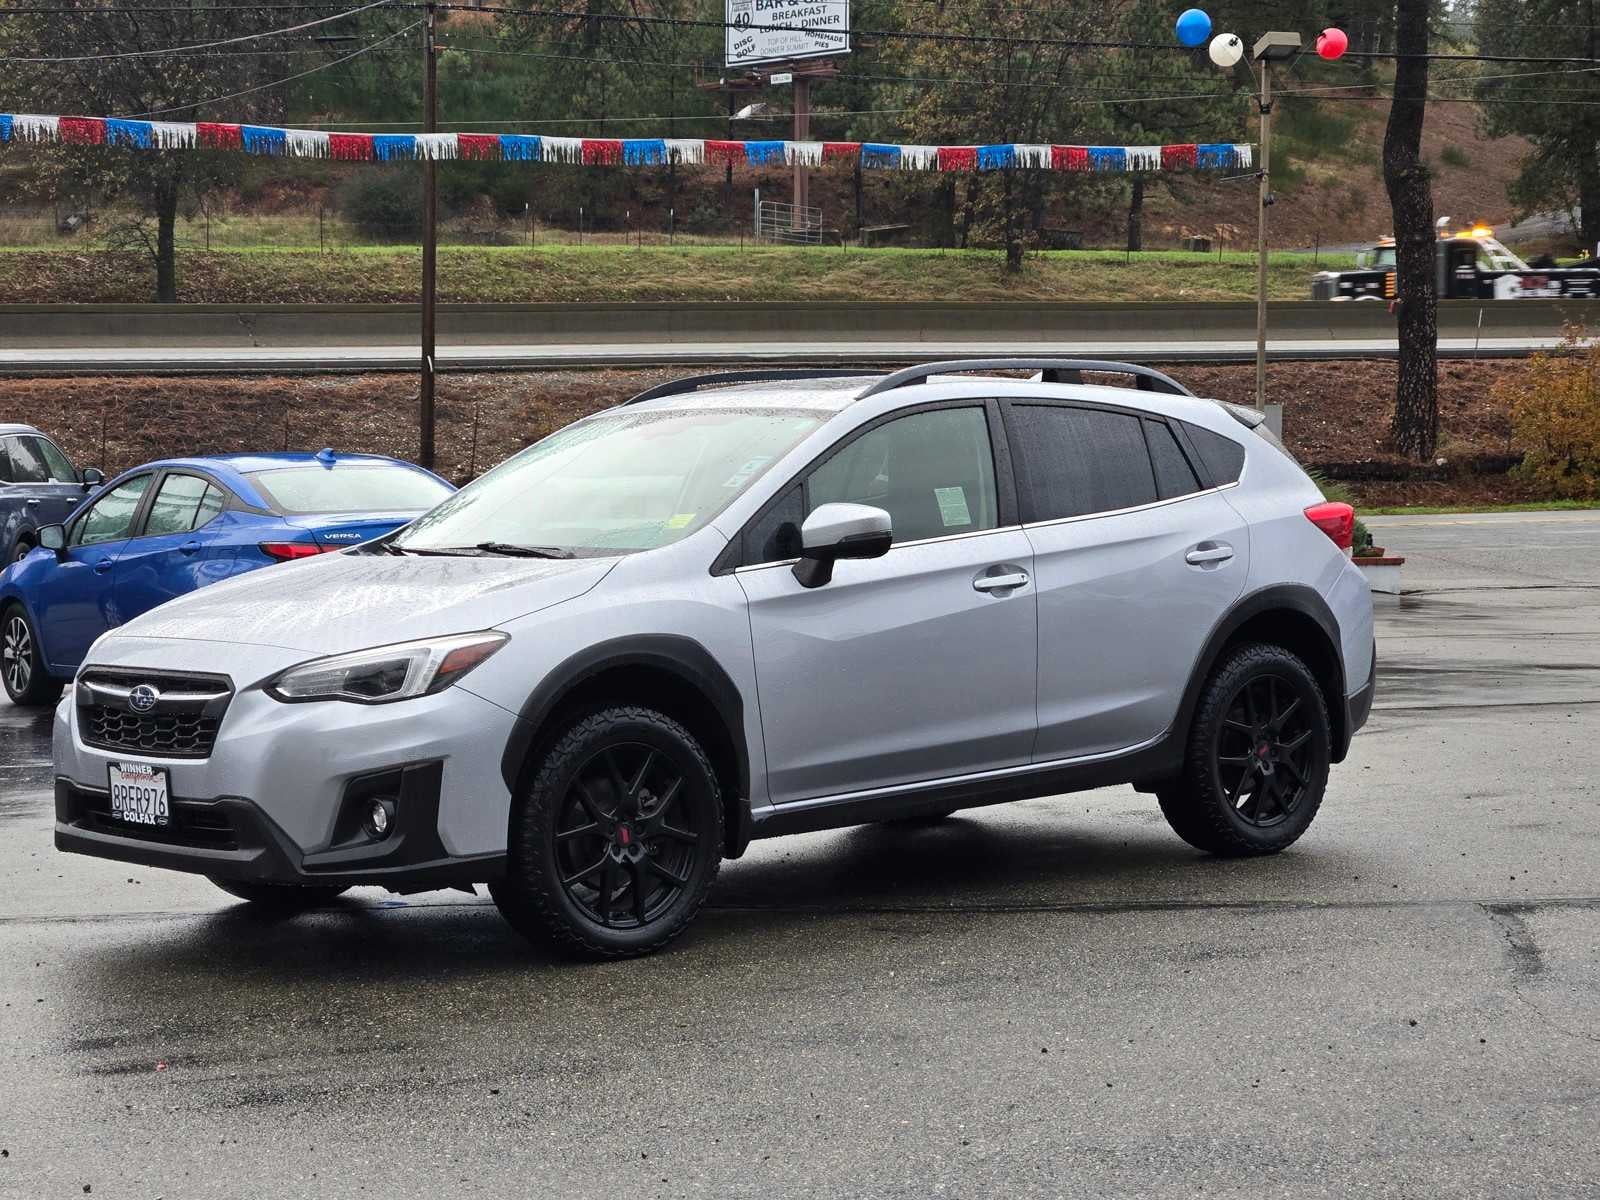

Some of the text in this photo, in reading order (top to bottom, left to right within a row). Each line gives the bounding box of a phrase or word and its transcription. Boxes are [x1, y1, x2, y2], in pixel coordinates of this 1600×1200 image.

[756, 0, 783, 11] BAR
[734, 12, 750, 27] 40
[772, 5, 827, 21] BREAKFAST
[760, 21, 793, 33] LUNCH
[801, 15, 840, 28] DINNER
[734, 35, 753, 50] DISC
[805, 31, 843, 43] HOMEMADE
[736, 44, 756, 58] GOLF
[814, 41, 829, 49] PIES
[120, 762, 153, 776] WINNER
[113, 784, 166, 815] 8RER976
[123, 811, 156, 825] COLFAX
